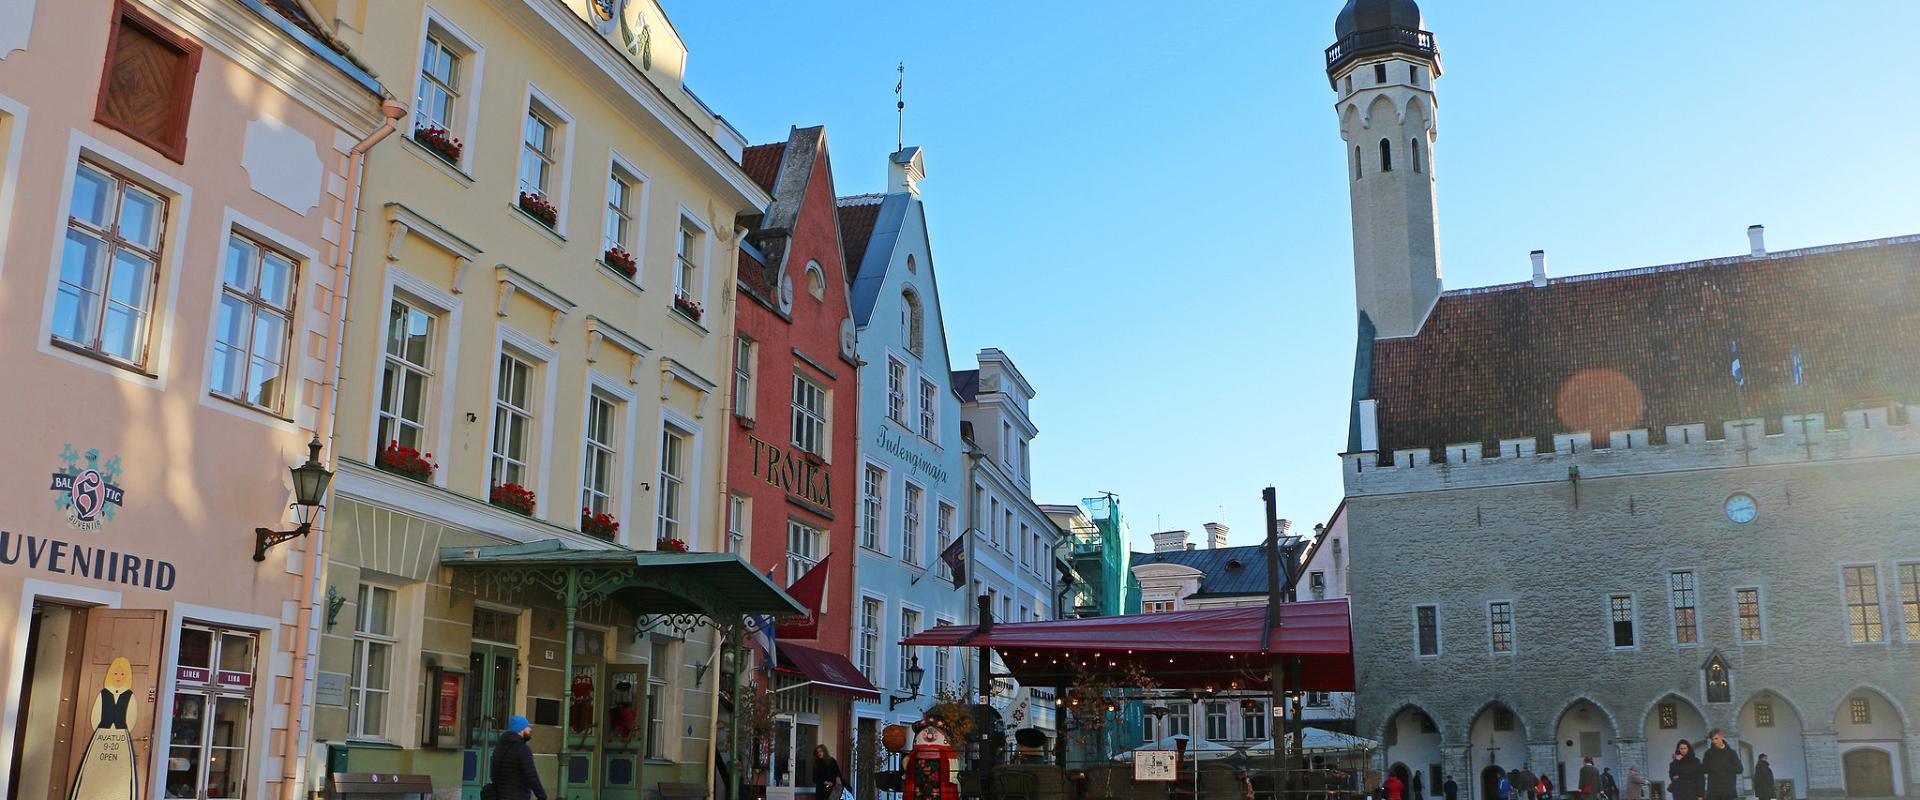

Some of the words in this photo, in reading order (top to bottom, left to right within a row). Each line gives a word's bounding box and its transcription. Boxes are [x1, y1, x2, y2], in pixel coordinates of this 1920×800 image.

[748, 434, 832, 509] TROIKA
[876, 424, 949, 487] Tudengimaja
[97, 734, 126, 742] AVATUD
[99, 752, 118, 762] OPEN
